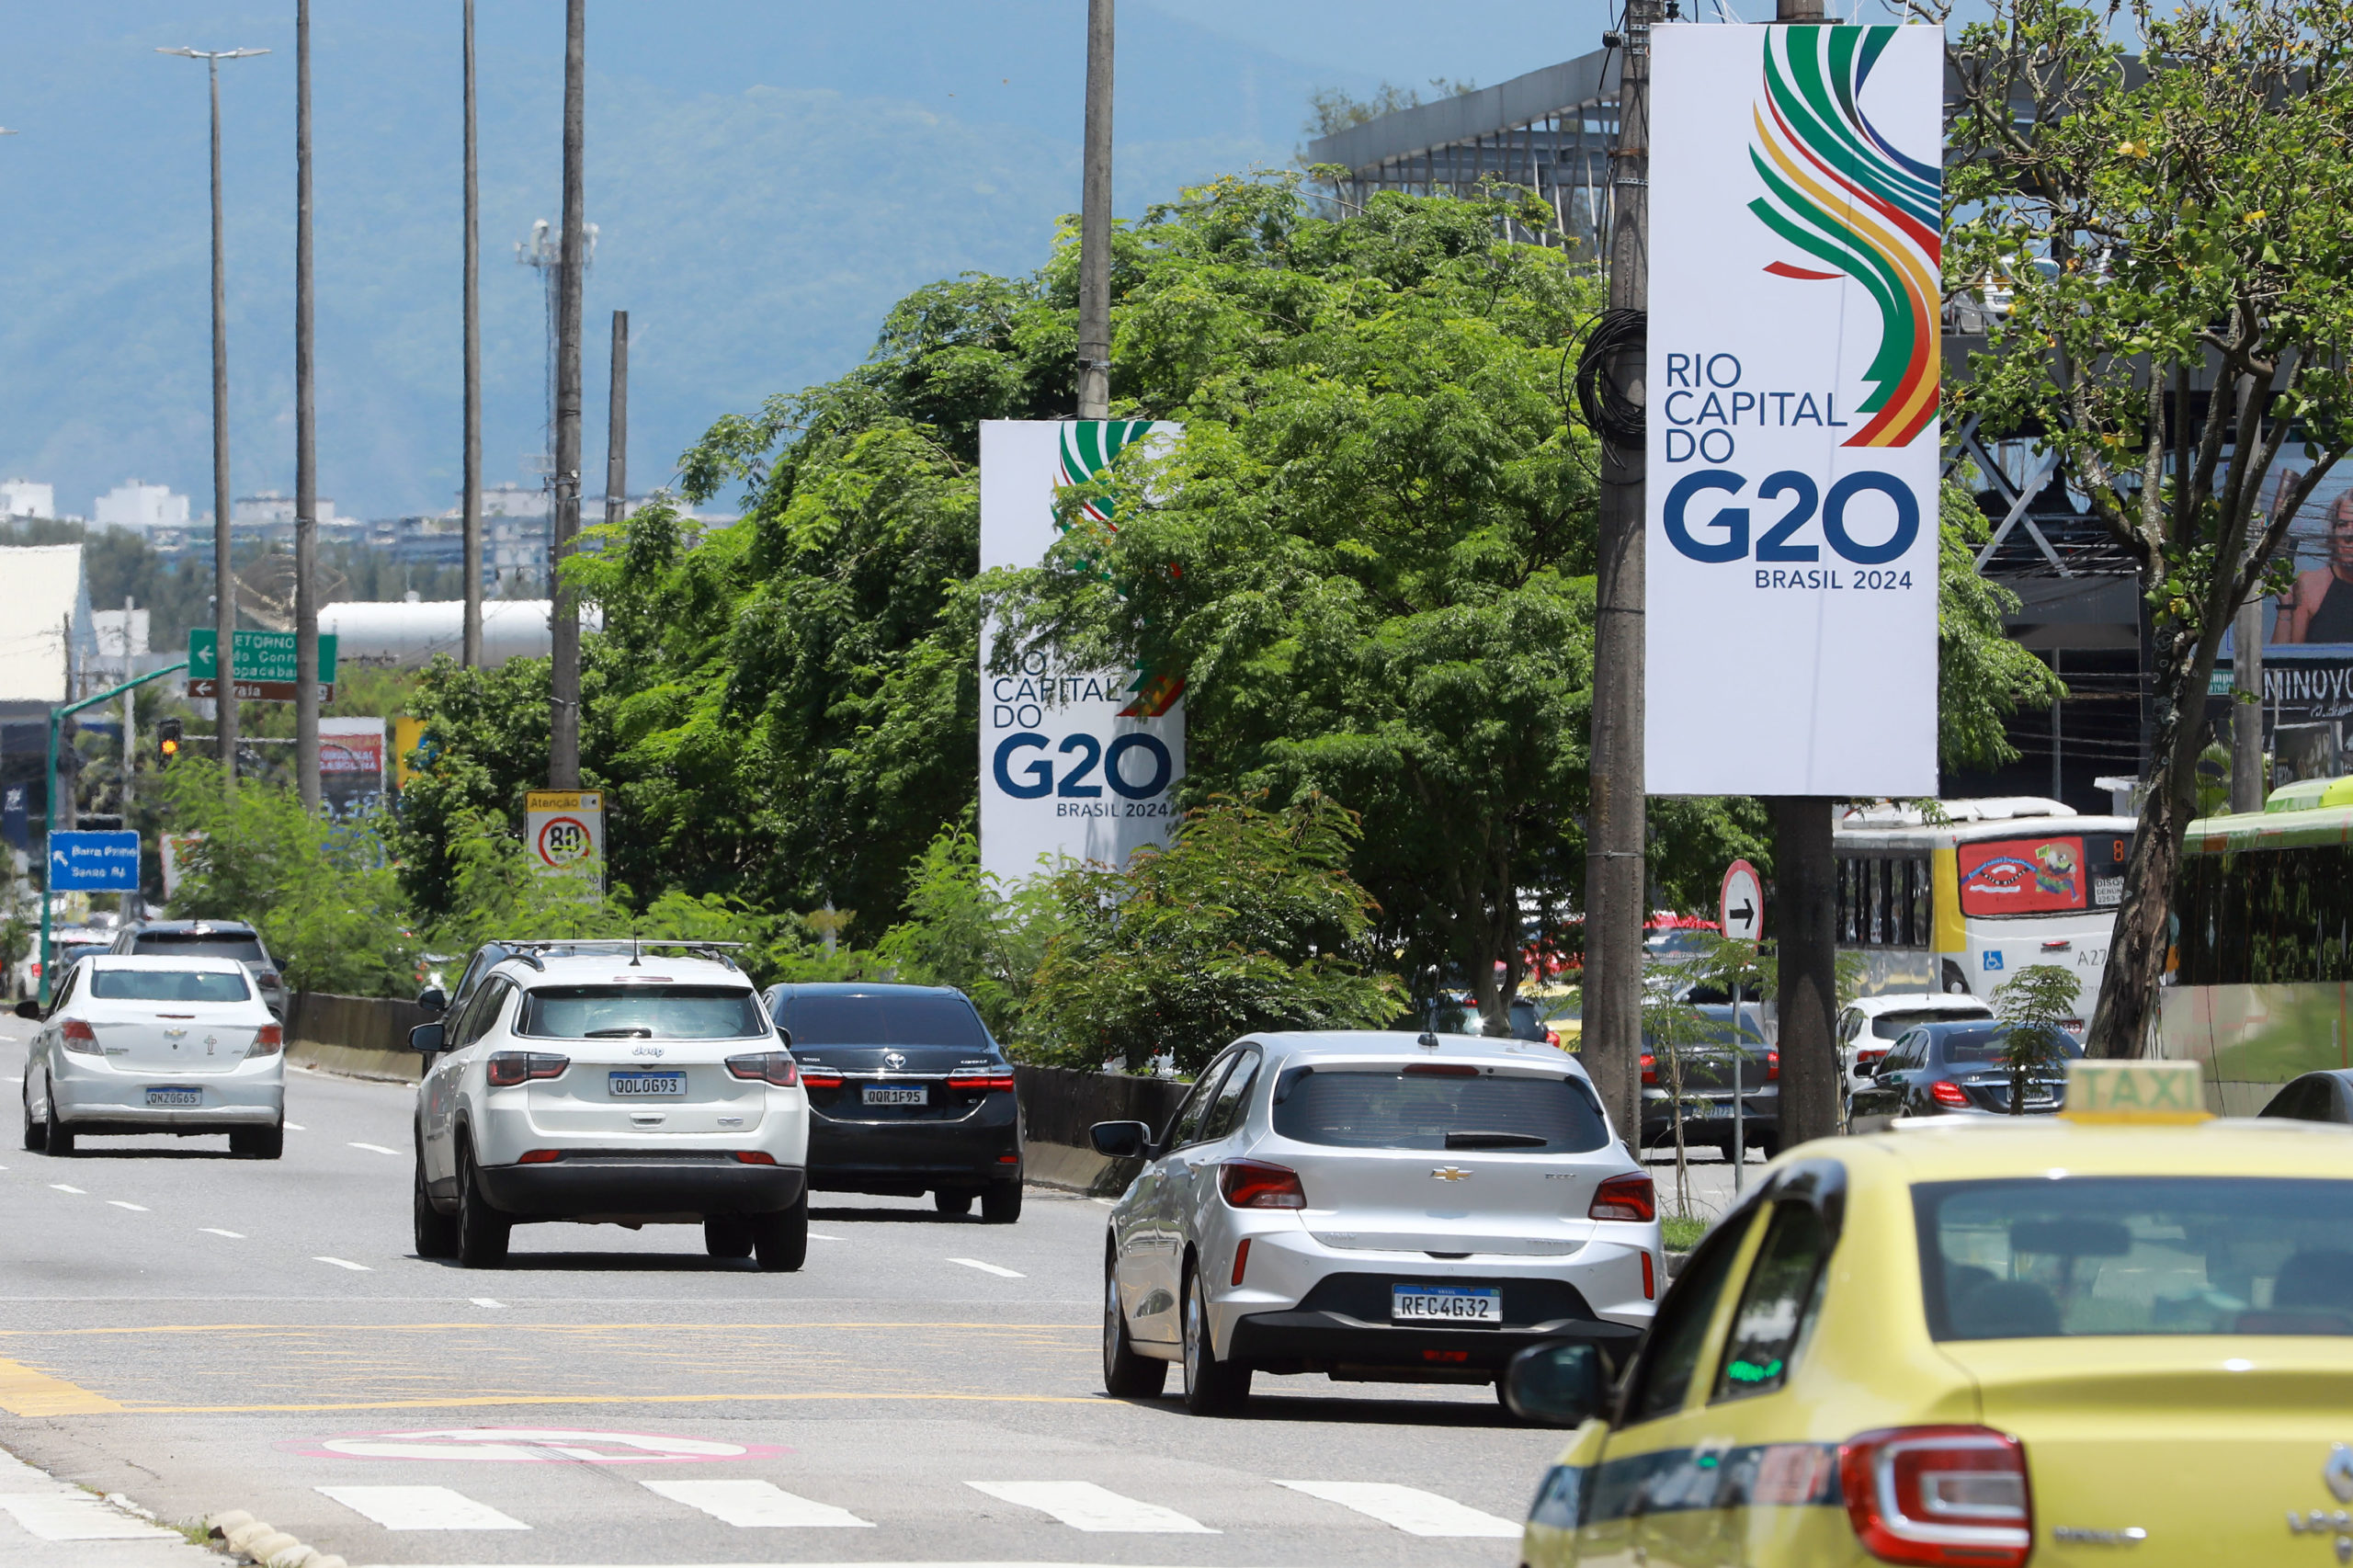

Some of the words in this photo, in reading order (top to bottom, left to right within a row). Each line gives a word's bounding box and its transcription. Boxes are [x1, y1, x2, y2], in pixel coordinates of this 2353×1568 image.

[1666, 353, 1742, 389] RIO
[1665, 391, 1848, 426] CAPITAL
[1666, 428, 1734, 464] DO
[1663, 469, 1920, 565] G20
[1756, 569, 1843, 589] BRASIL
[1853, 570, 1913, 590] 2024
[234, 634, 294, 649] ETORNO
[258, 651, 296, 664] Conr
[233, 665, 296, 680] opacaba
[233, 685, 261, 697] raia
[994, 677, 1121, 702] CAPITAL
[994, 704, 1042, 729] DO
[993, 732, 1172, 801] G20
[530, 798, 578, 809] Atenção
[1057, 802, 1119, 817] BRASIL
[1126, 802, 1168, 817] 2024
[550, 825, 580, 852] 80
[2077, 949, 2108, 966] A27
[2076, 1068, 2195, 1108] TAXI
[1402, 1296, 1489, 1318] REC4G32
